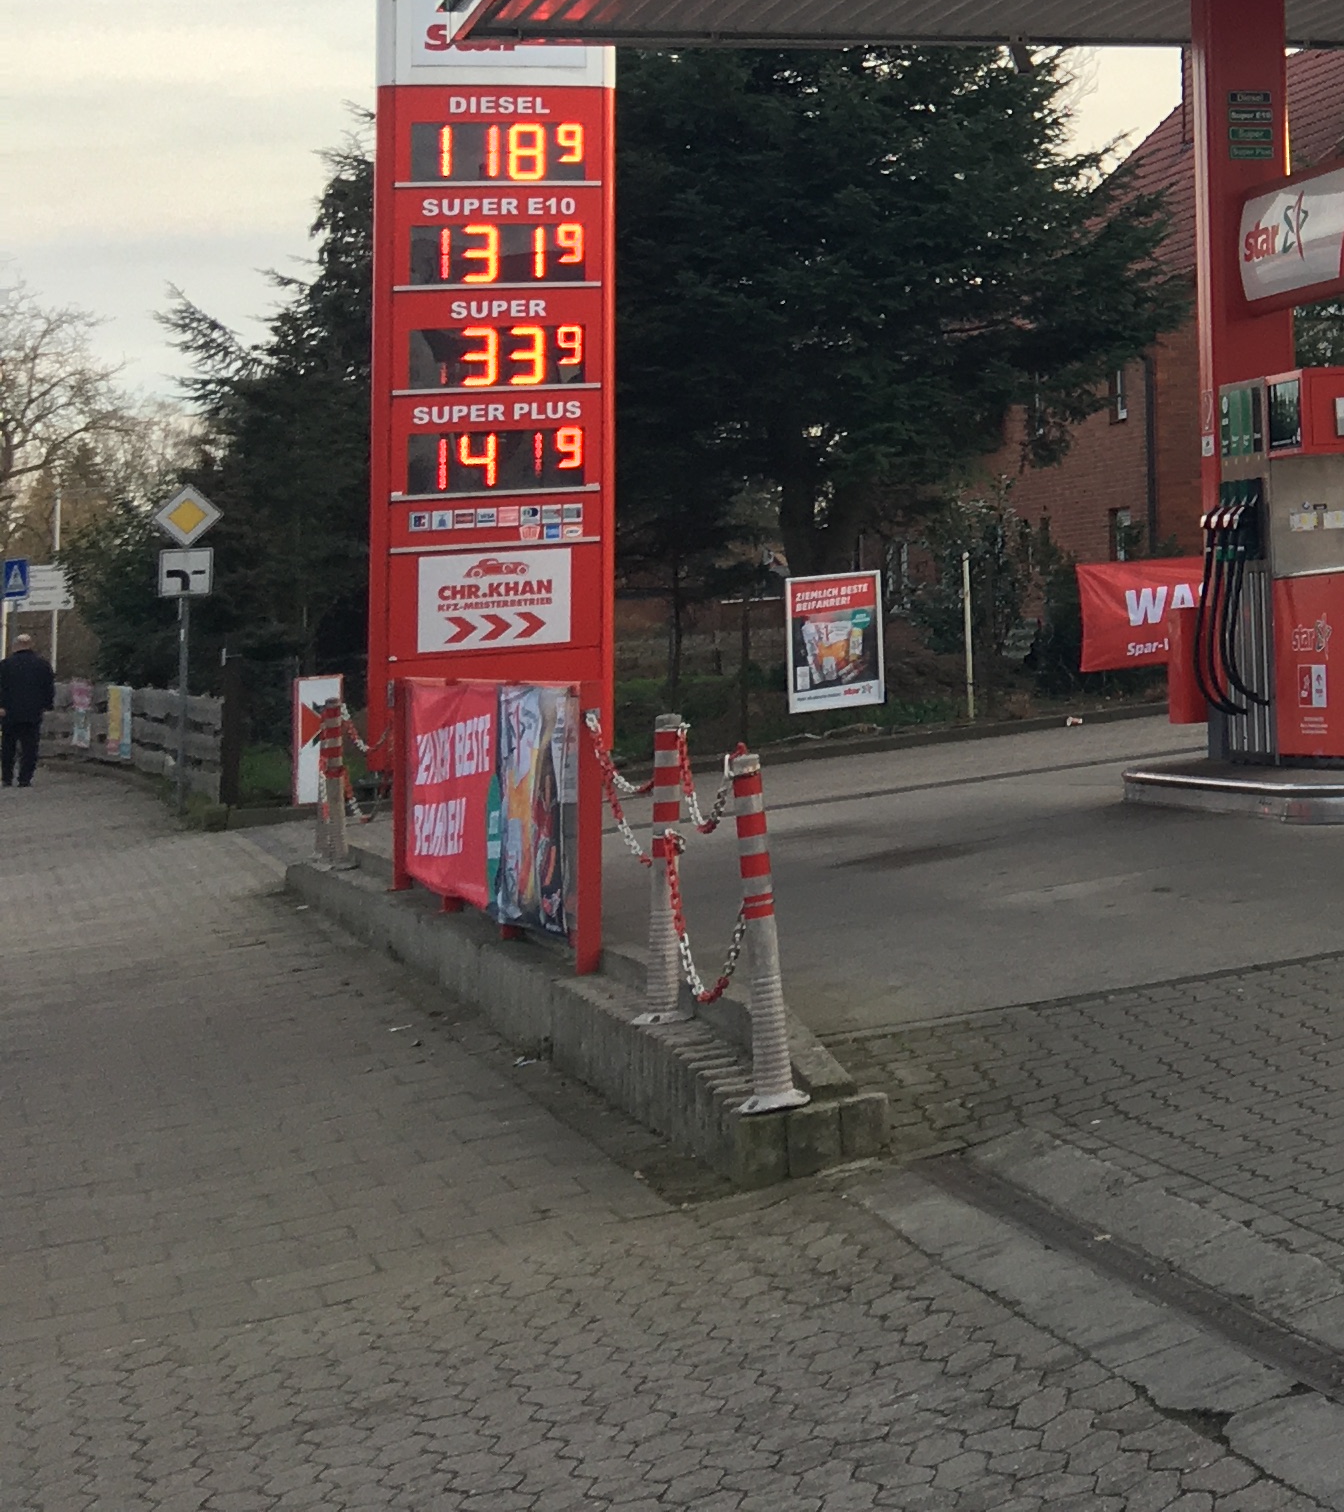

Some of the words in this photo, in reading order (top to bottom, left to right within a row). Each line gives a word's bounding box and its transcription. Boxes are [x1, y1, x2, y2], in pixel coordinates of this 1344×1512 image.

[449, 96, 550, 114] DIESEL
[422, 198, 518, 217] SUPER
[528, 197, 576, 215] E10
[1244, 219, 1280, 262] star
[451, 300, 546, 319] SUPER
[413, 404, 504, 424] SUPER
[513, 400, 581, 420] PLUS
[437, 579, 553, 602] CHR.KHAN
[1125, 582, 1204, 626] WA
